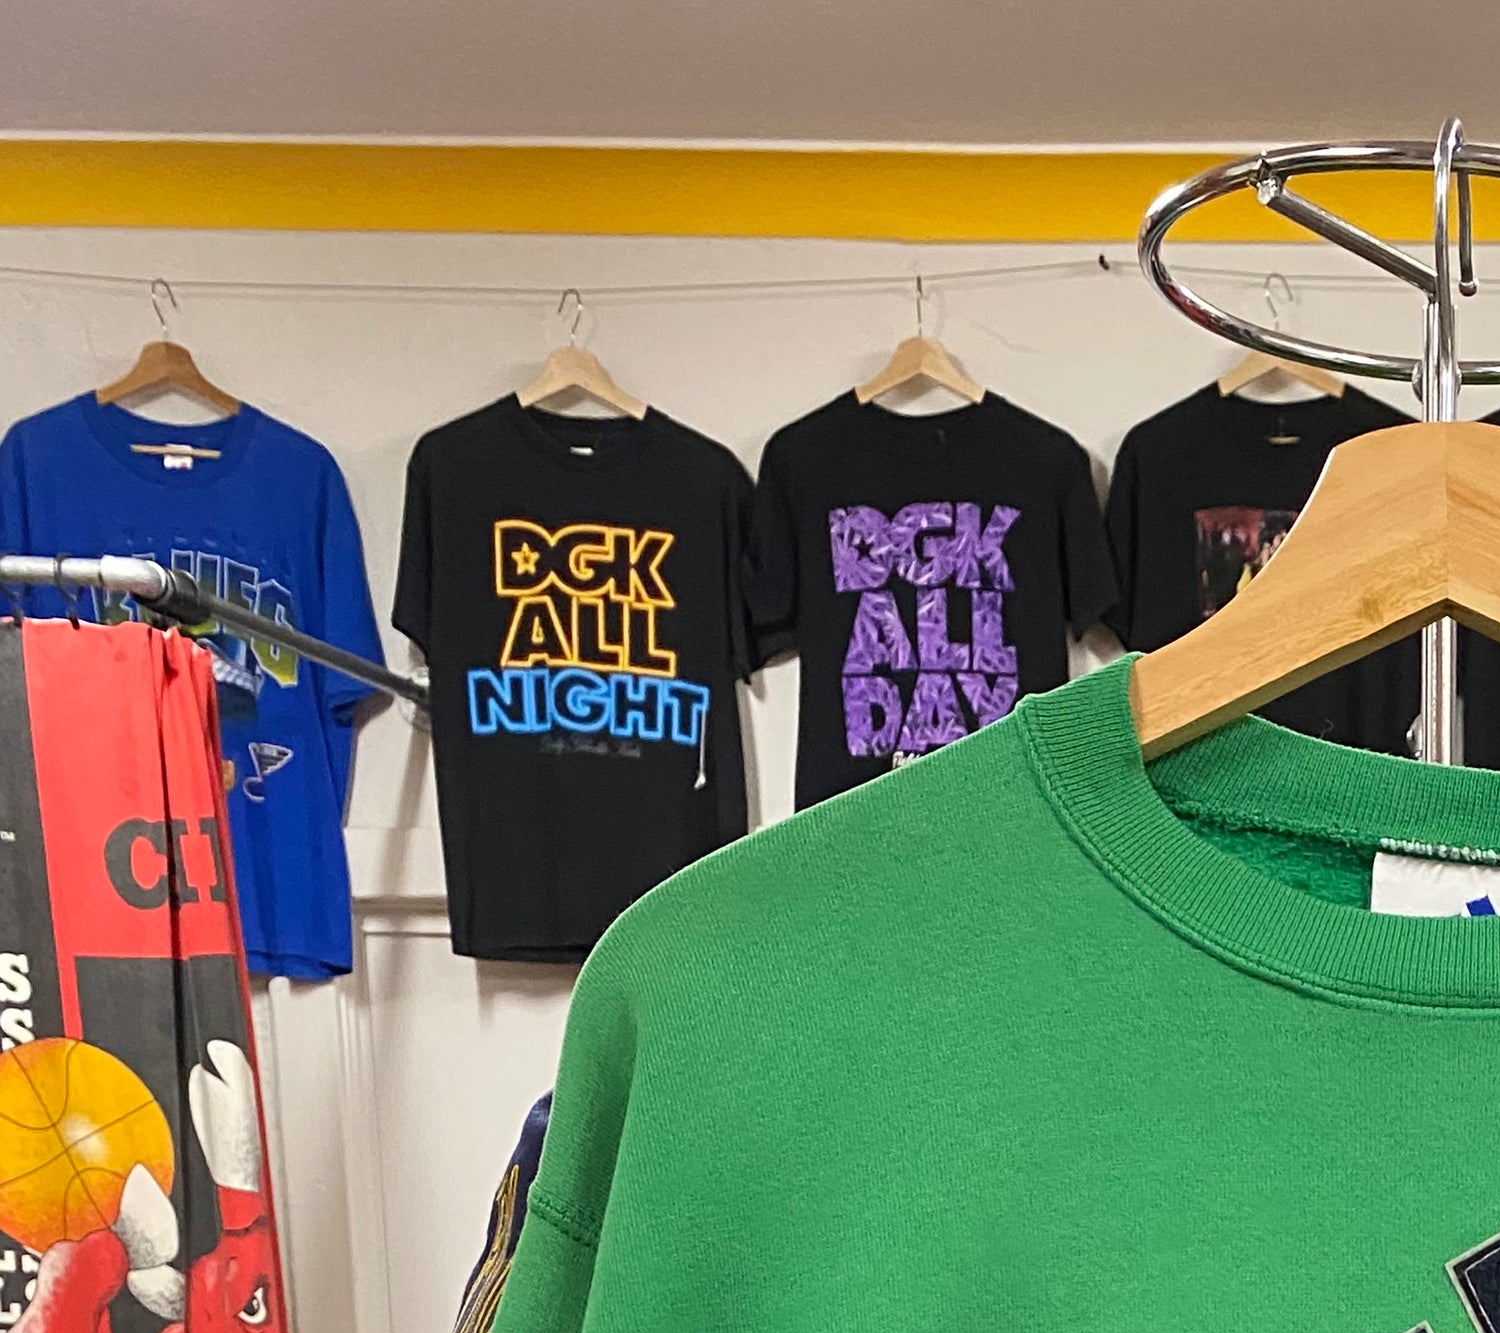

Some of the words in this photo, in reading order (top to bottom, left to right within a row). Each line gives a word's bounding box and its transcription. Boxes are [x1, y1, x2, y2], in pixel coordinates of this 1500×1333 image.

[494, 519, 675, 609] DGK
[829, 502, 1021, 593] DGK
[501, 595, 676, 677] ALL
[842, 587, 1017, 674] ALL
[467, 669, 709, 745] NIGHT
[842, 672, 1018, 757] DAY
